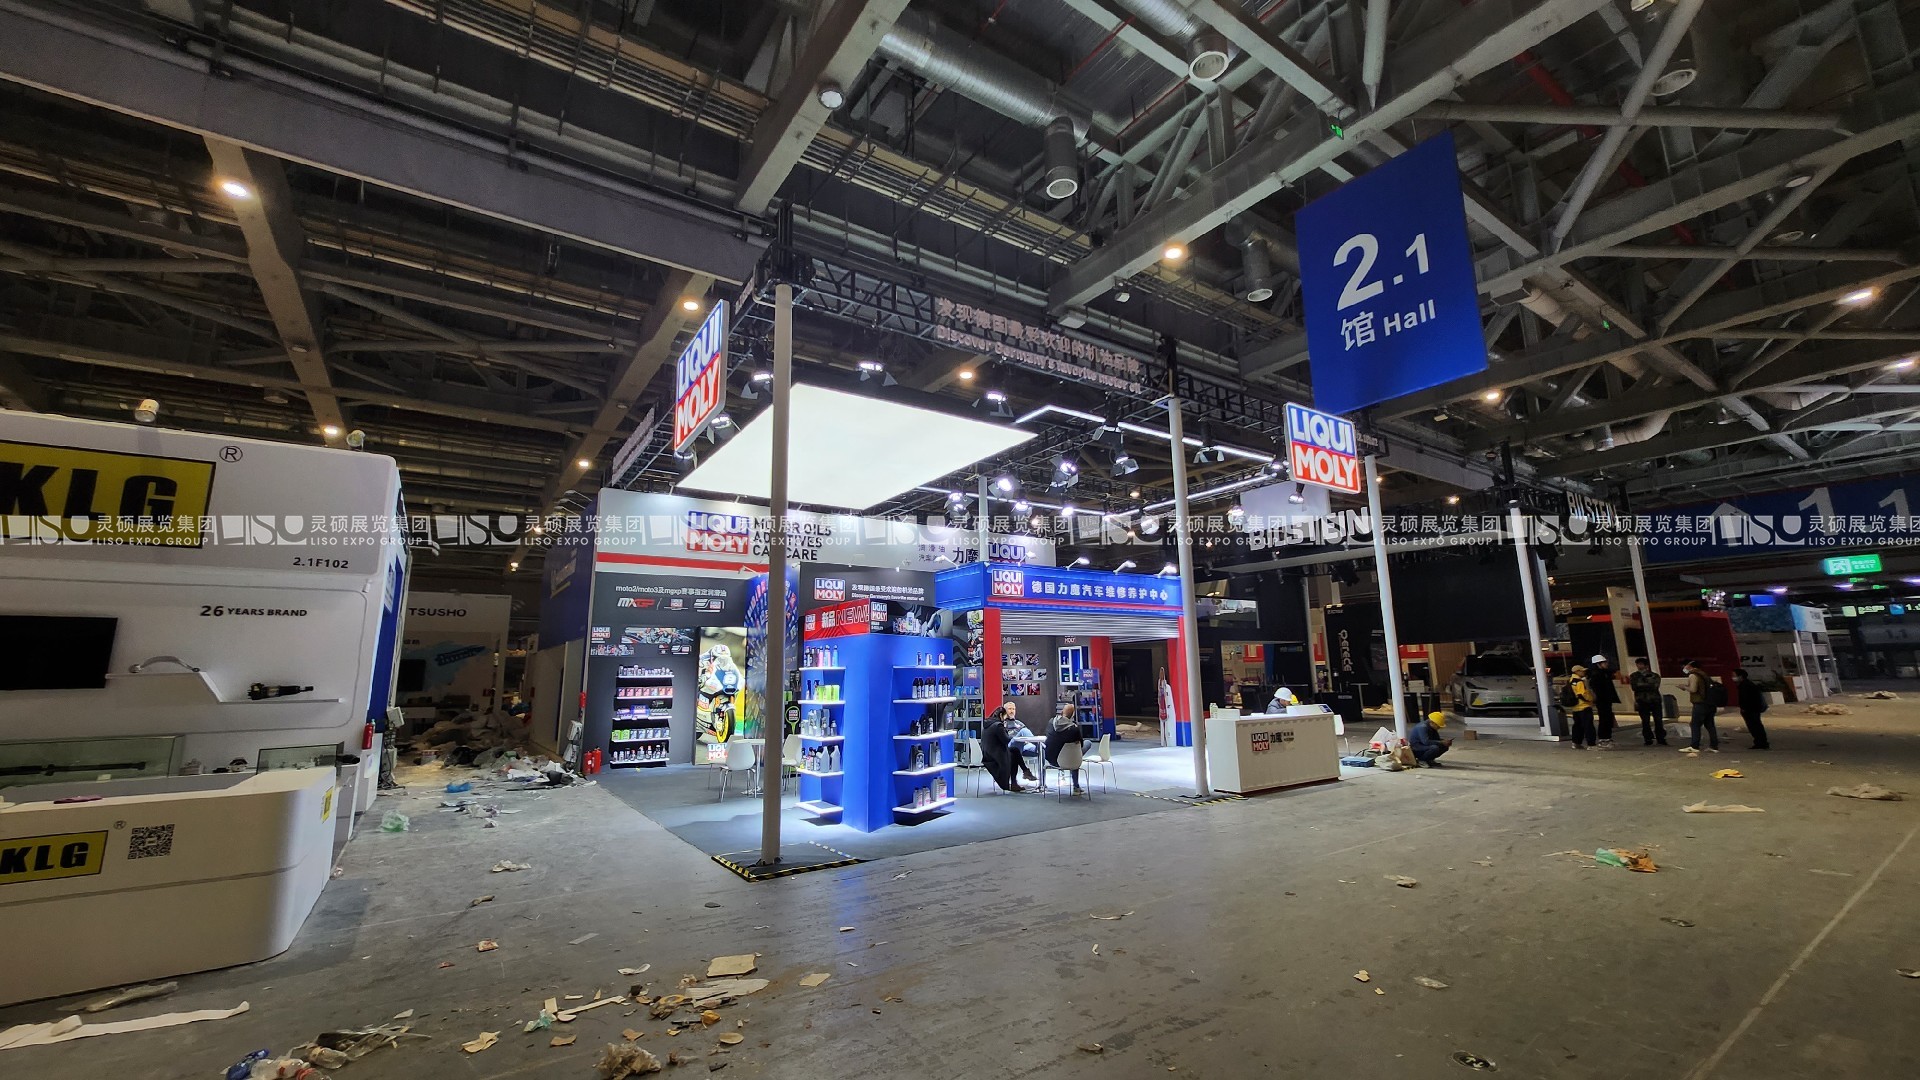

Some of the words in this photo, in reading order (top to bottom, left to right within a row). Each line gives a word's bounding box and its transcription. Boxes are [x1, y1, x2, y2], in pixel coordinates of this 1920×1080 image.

[1333, 233, 1429, 311] 2.1
[1340, 311, 1376, 351] 馆
[1383, 299, 1436, 336] Hall
[937, 324, 992, 352] Discover
[678, 306, 720, 395] LIQUI
[676, 359, 719, 446] MOLY
[1290, 408, 1355, 455] LIQUI
[1294, 445, 1357, 487] MOLY
[0, 461, 178, 525] KLG
[690, 512, 748, 534] LIQUI
[1250, 507, 1372, 551] BILSTEIN
[690, 532, 748, 553] MOLY
[293, 557, 349, 569] 2.1F102
[953, 547, 979, 564] 力魔
[816, 579, 844, 590] LIQUI
[994, 571, 1022, 583] LIQUI
[816, 590, 844, 599] MOLY
[994, 583, 1022, 595] MOLY
[1031, 580, 1169, 600] 德国力魔汽车维修养护中心
[200, 605, 225, 617] 26
[228, 608, 265, 616] YEARS
[267, 609, 307, 617] BRAND
[408, 608, 467, 617] TSUSHO
[1253, 742, 1269, 751] MOLY
[0, 842, 89, 874] KLG
